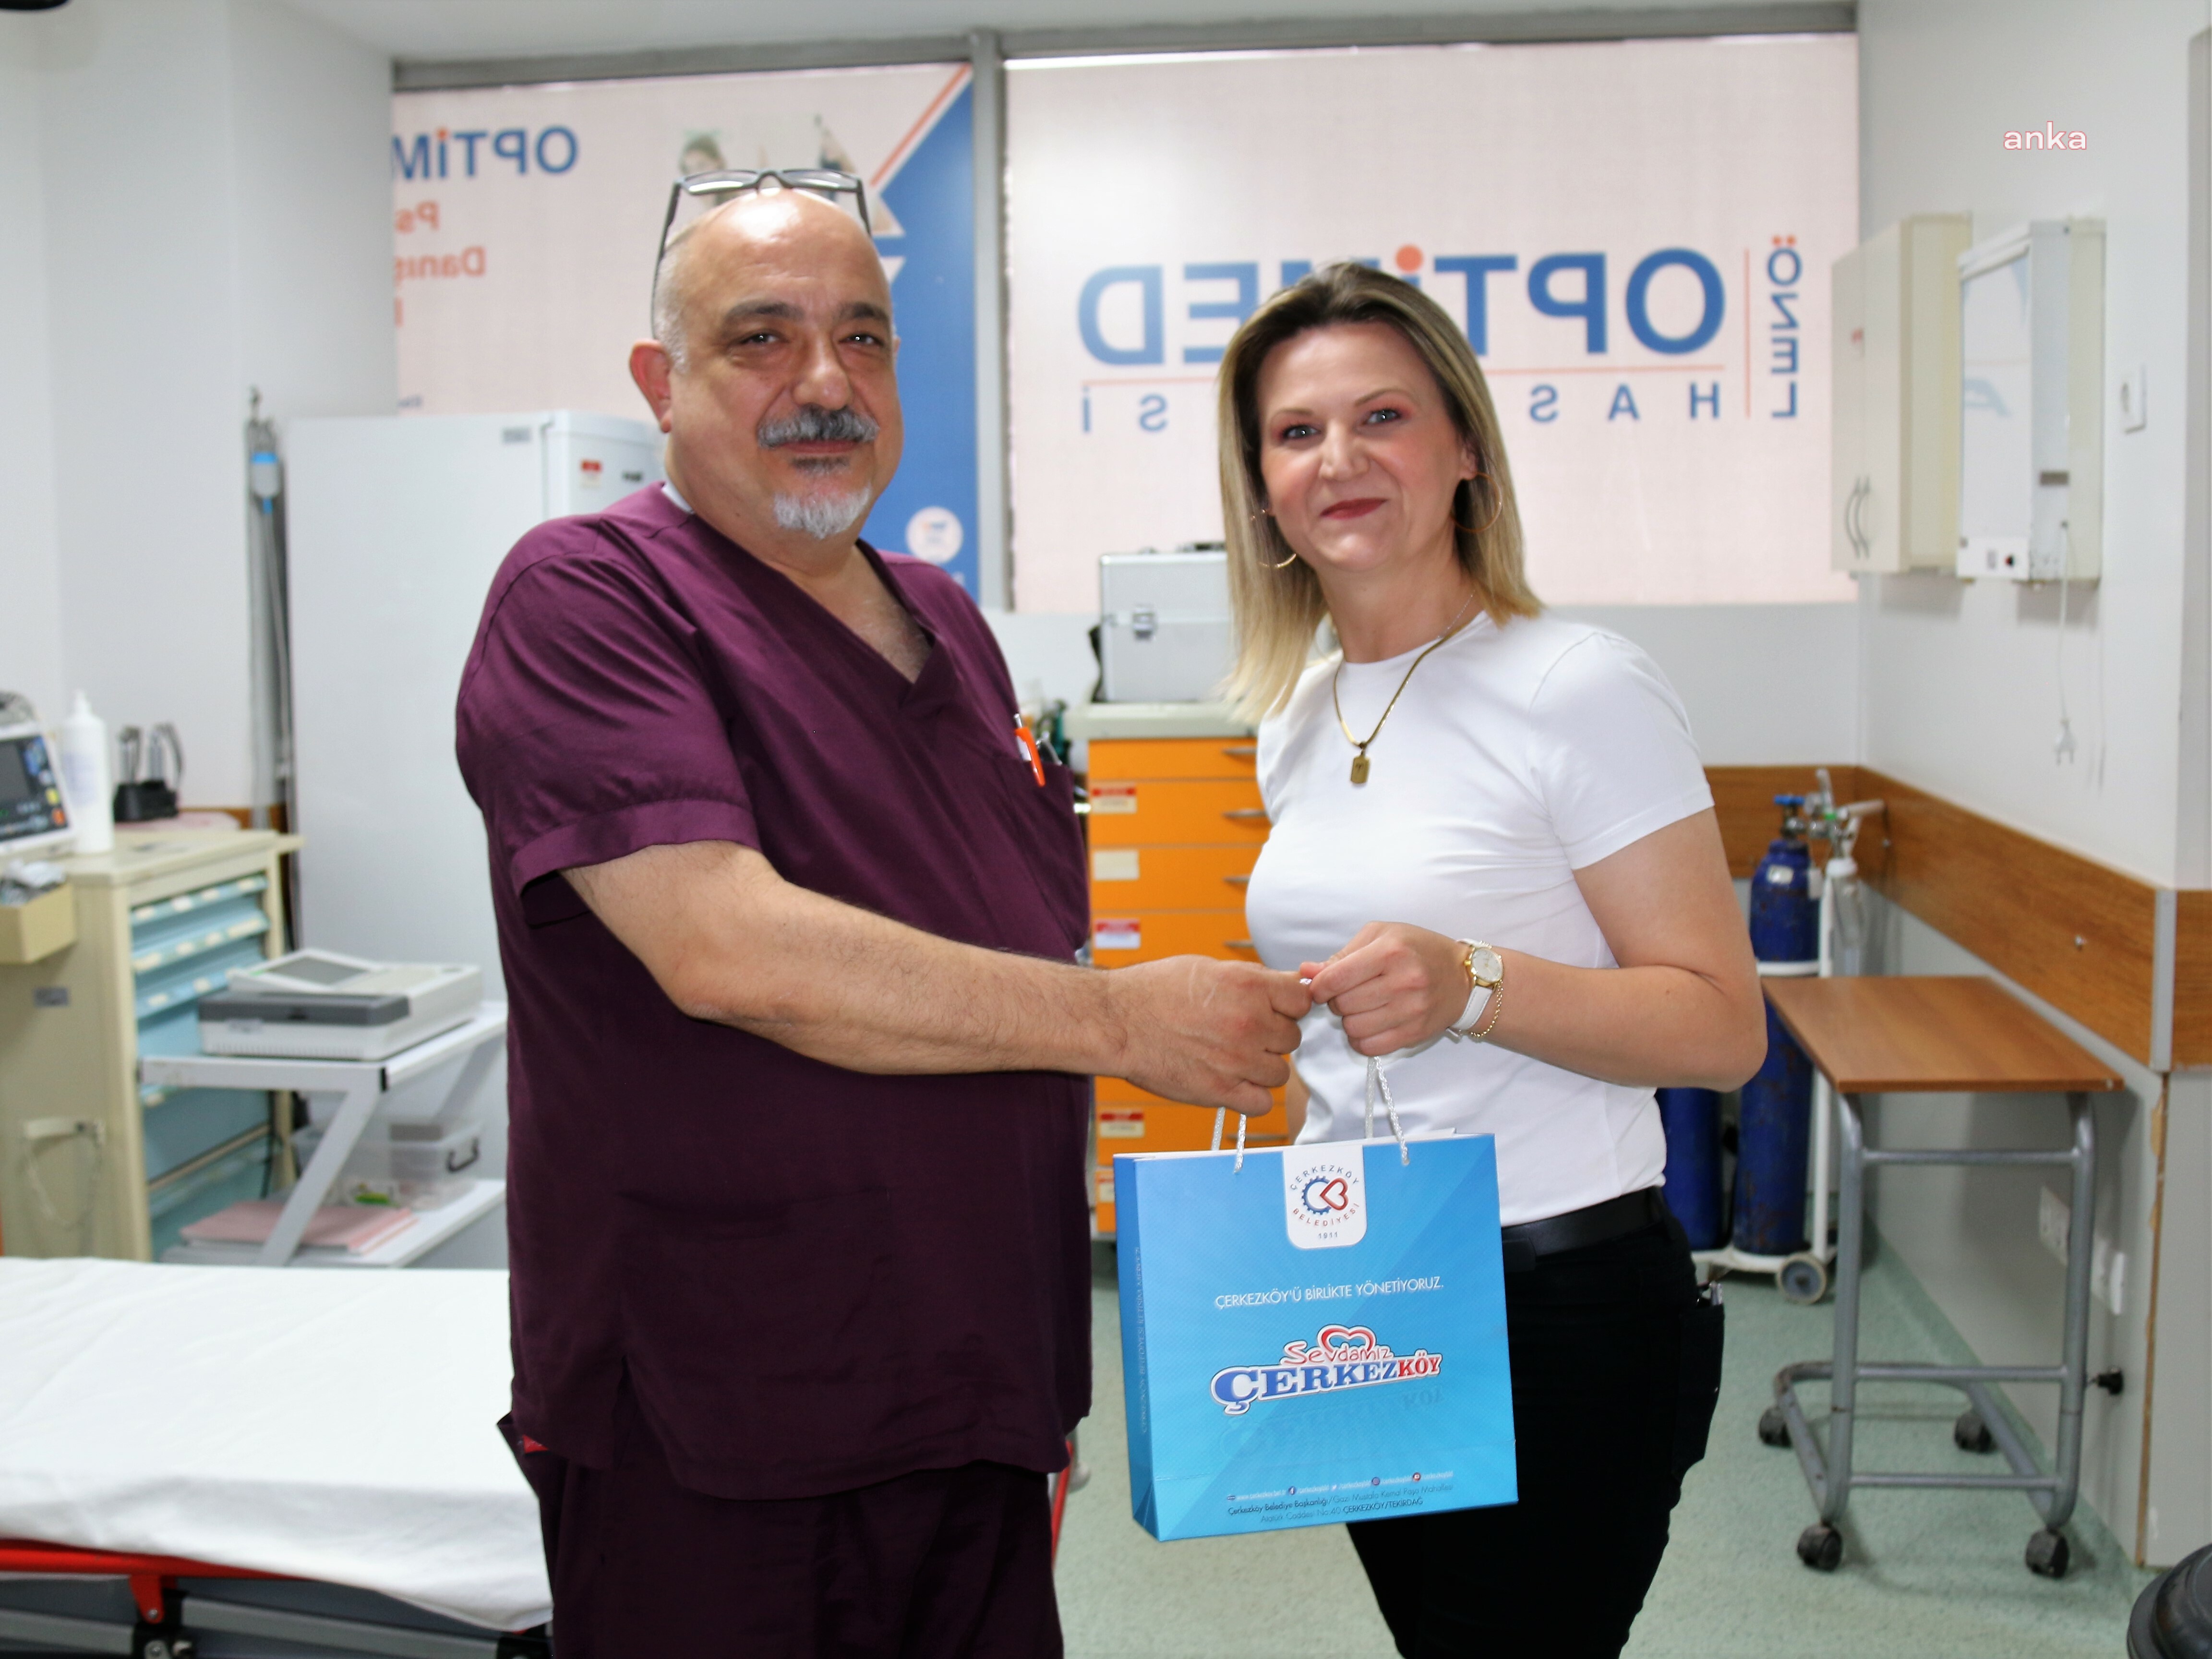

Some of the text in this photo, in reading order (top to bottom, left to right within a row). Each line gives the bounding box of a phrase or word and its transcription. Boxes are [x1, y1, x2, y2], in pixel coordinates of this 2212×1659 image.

[1290, 1165, 1359, 1190] ÇERKEZKÖY
[1215, 1276, 1443, 1309] ÇERKEZKÖY'Ü BİRLİKTE YÖNETİYORUZ.
[1214, 1352, 1441, 1412] ÇERKEZKÖY
[1228, 1504, 1263, 1516] Çerkezköy
[1265, 1502, 1293, 1512] Belediye
